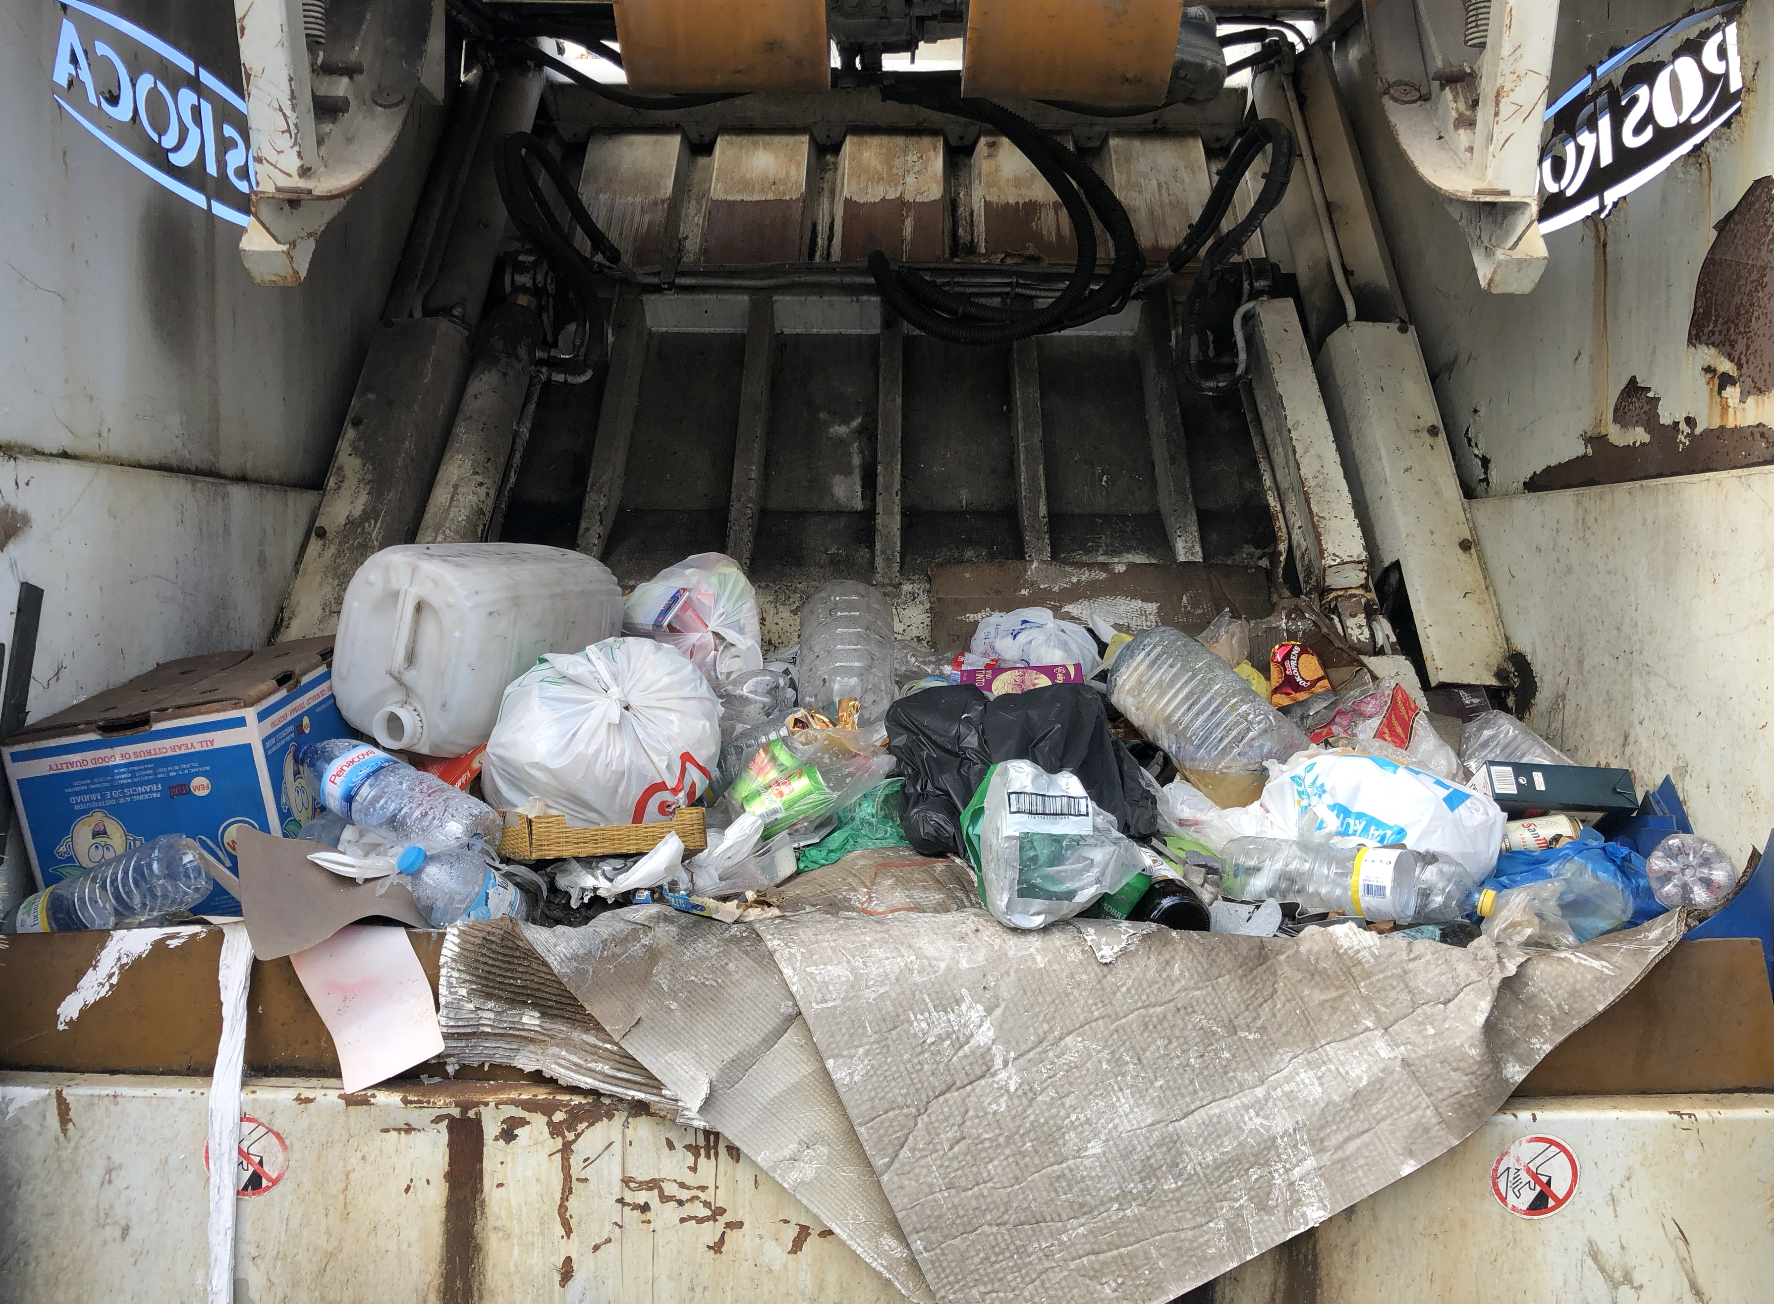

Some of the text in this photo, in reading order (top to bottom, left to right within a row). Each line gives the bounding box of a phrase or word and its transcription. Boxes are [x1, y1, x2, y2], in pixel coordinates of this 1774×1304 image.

[48, 737, 215, 772] ALL YEAR CITRUS OF GOOD QUALITY
[329, 748, 376, 787] Penacova
[69, 783, 162, 804] FRANCISCO E. MUDAD
[191, 783, 211, 793] FEM
